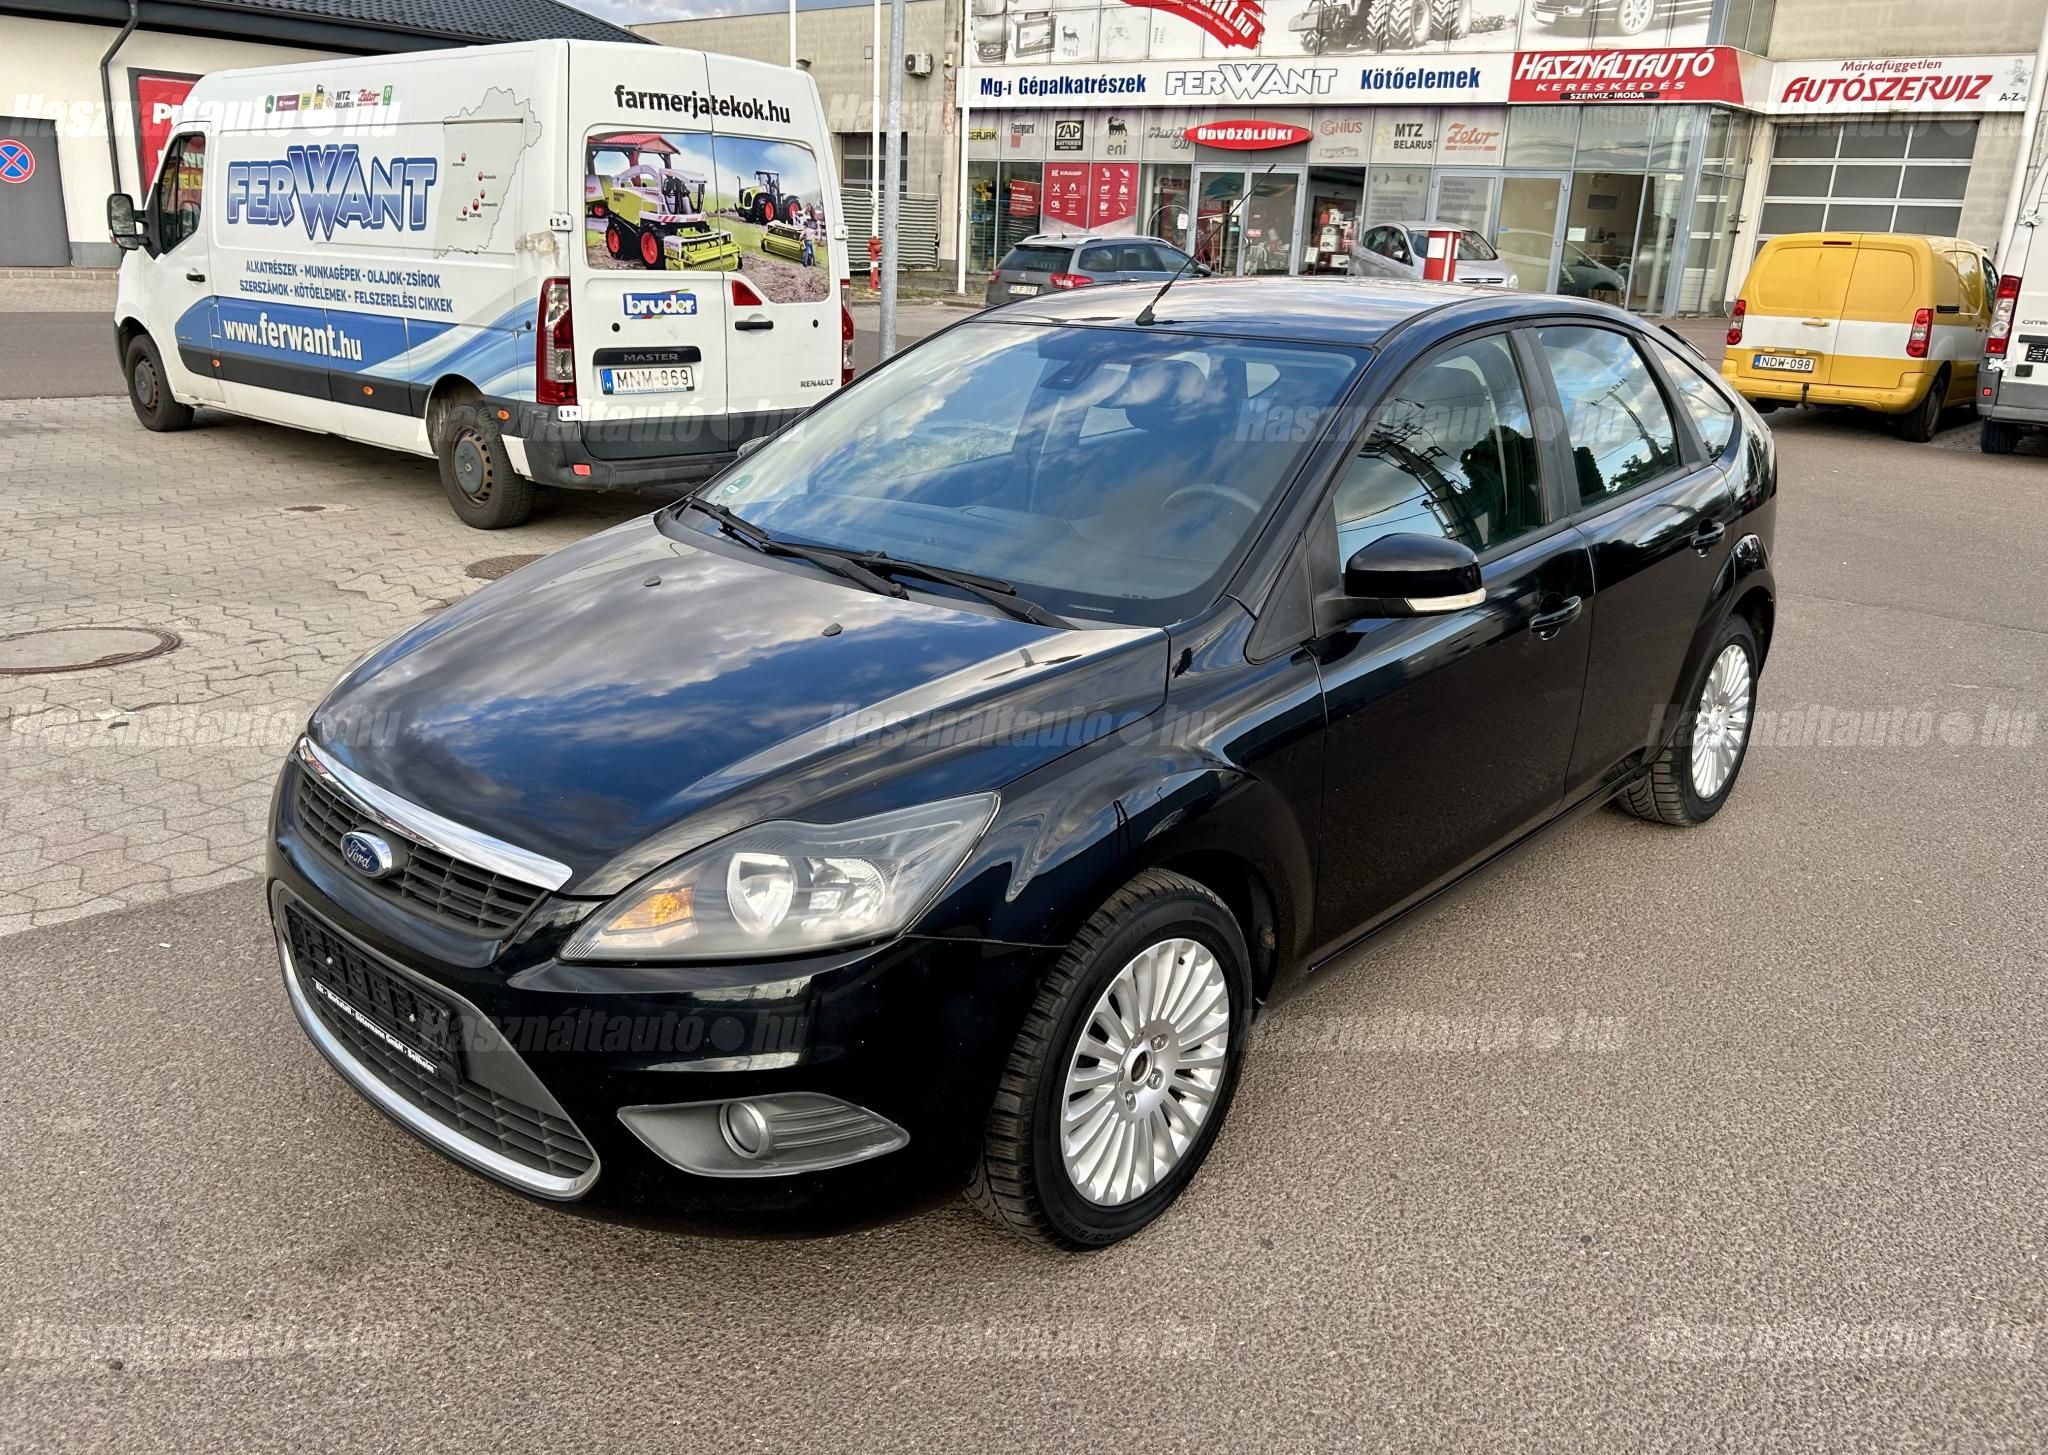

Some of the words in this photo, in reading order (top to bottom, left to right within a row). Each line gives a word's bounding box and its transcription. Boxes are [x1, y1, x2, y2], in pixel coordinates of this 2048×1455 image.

[1514, 49, 1715, 80] HASZNÁLTAUTÓ
[1840, 59, 1943, 73] Márkafüggetlen
[980, 77, 1012, 97] Mg-i
[1018, 74, 1147, 97] Gépalkatrészek
[1165, 64, 1338, 100] FERWANT
[1360, 67, 1481, 90] Kötőelemek
[1535, 80, 1687, 92] KERESKEDÉS
[1781, 73, 1994, 104] AUTÓSZERVIZ
[614, 84, 790, 123] farmerjatekok.hu
[1057, 124, 1080, 138] ZAP
[1197, 127, 1294, 140] ÜDVÖZÖLJÜK!
[1395, 123, 1424, 138] MTZ
[1447, 122, 1500, 144] Zetor
[1107, 139, 1127, 156] eni
[1393, 140, 1433, 150] BELARUS
[227, 144, 438, 241] FERWANT
[246, 260, 298, 277] ALKATRÉSZEK
[304, 264, 361, 282] MUNKAGÉPEK
[239, 280, 289, 297] SZERSZÁMOK
[354, 290, 417, 310] FELSZERELÉSI
[418, 297, 454, 313] CIKKEK
[623, 294, 696, 315] bruder
[223, 312, 363, 361] www.ferwant.hu
[623, 352, 679, 362] MASTER
[1762, 356, 1811, 370] NDW-098
[616, 369, 690, 389] MNM-869
[800, 378, 835, 388] RENAULT
[346, 839, 373, 869] Ford
